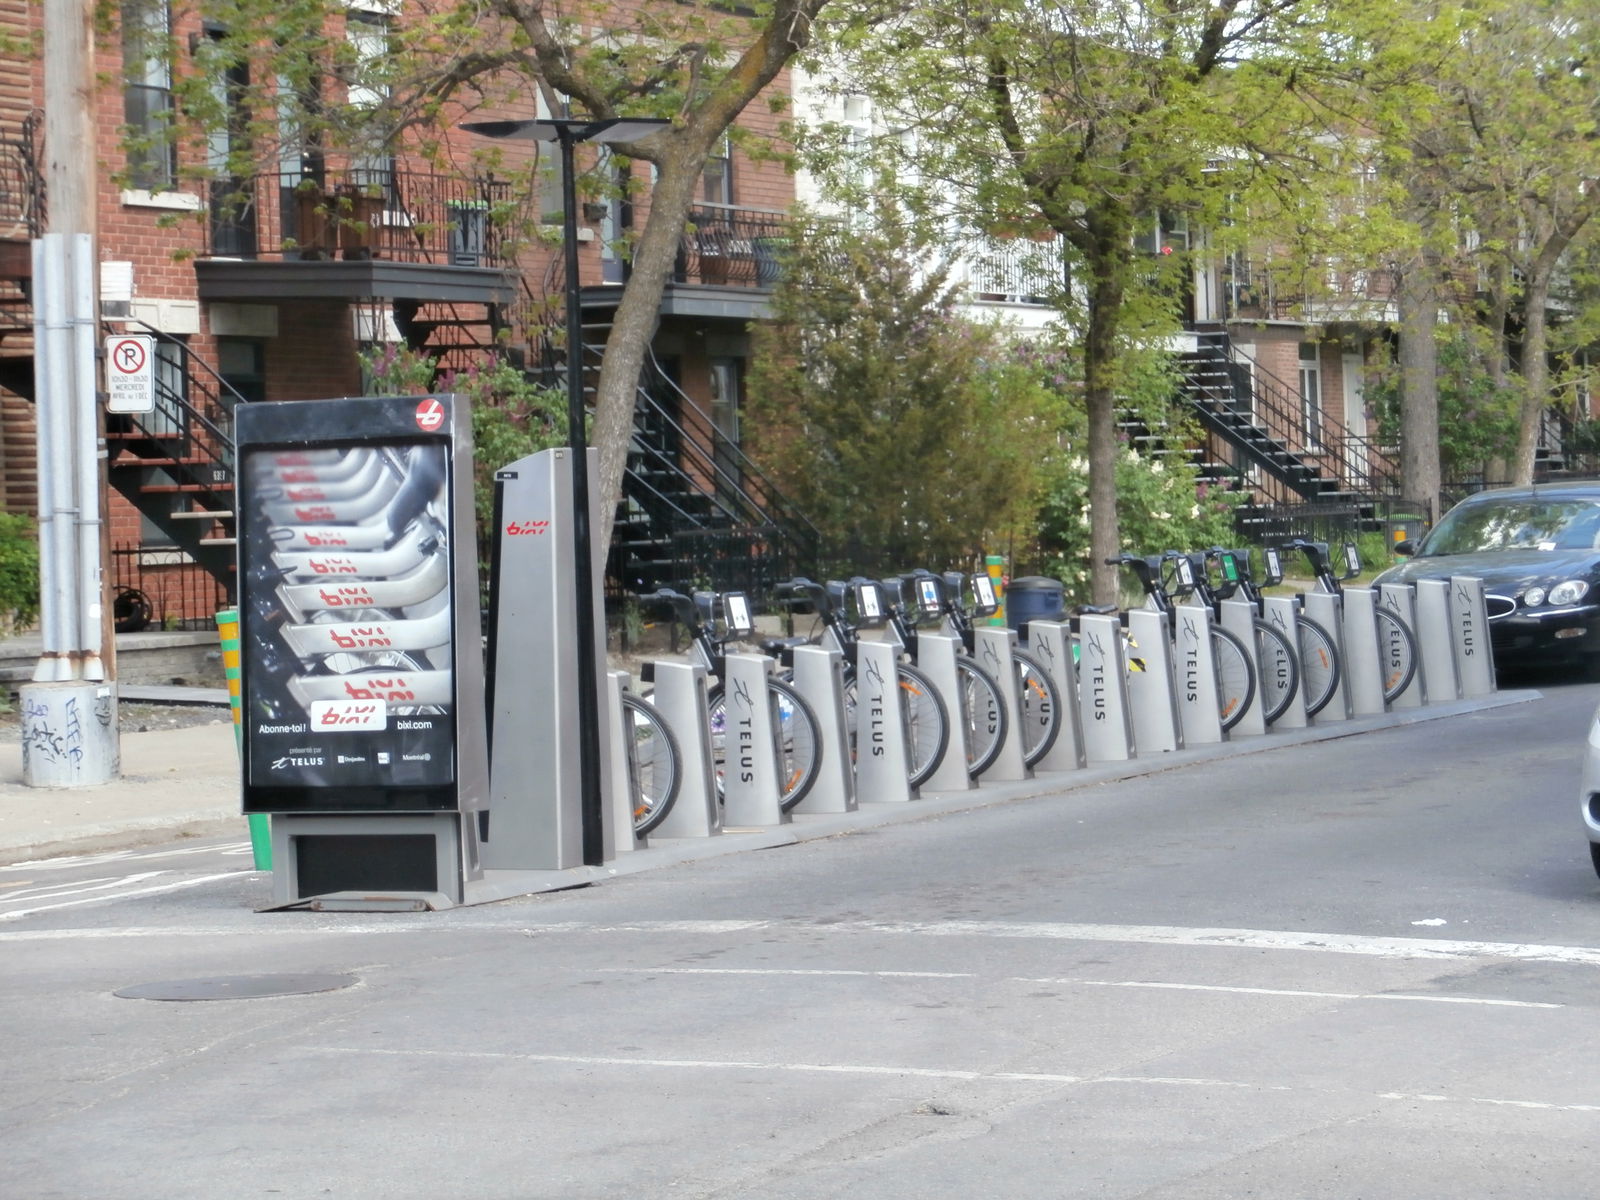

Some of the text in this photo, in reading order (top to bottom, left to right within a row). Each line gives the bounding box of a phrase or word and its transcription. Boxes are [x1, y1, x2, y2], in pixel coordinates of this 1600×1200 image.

[506, 520, 549, 536] bixi
[1390, 625, 1401, 668] ELUS
[1462, 611, 1474, 656] TELUS
[1186, 649, 1198, 702] TELUS
[1276, 649, 1288, 689] ELUS
[1093, 665, 1106, 721] TELUS
[321, 705, 376, 725] bixi
[397, 720, 432, 730] bixi.com
[870, 695, 884, 757] TELUS
[290, 757, 324, 766] TELUS
[740, 718, 753, 783] TELUS
